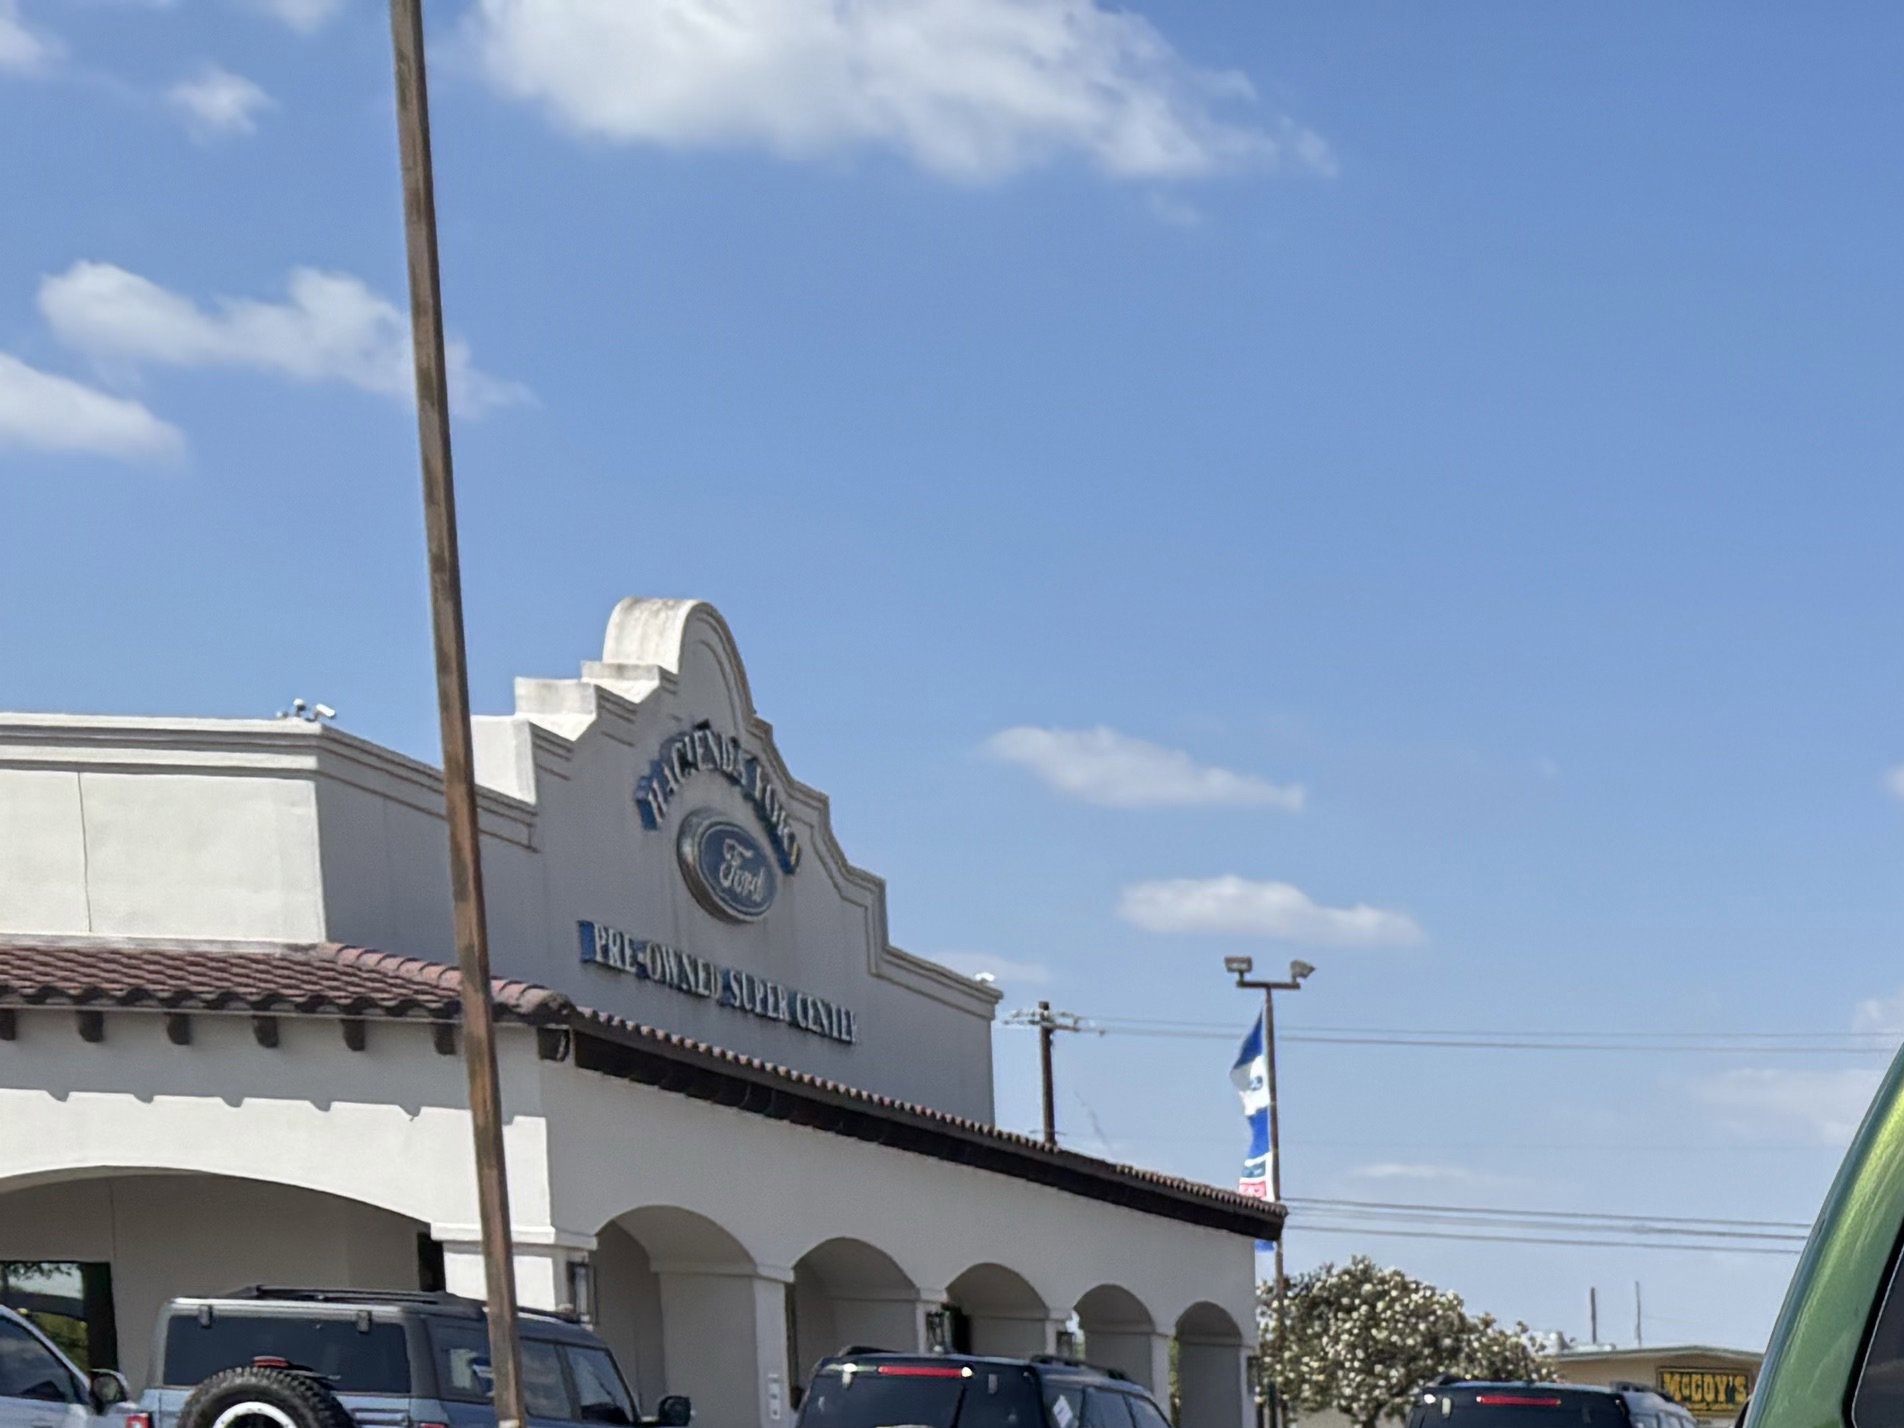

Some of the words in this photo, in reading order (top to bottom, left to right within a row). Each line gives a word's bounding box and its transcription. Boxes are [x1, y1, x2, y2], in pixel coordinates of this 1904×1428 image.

[719, 838, 768, 903] Ford
[586, 921, 723, 1001] PRE-OWNED
[729, 969, 793, 1022] SUPER
[797, 990, 857, 1043] CENTER
